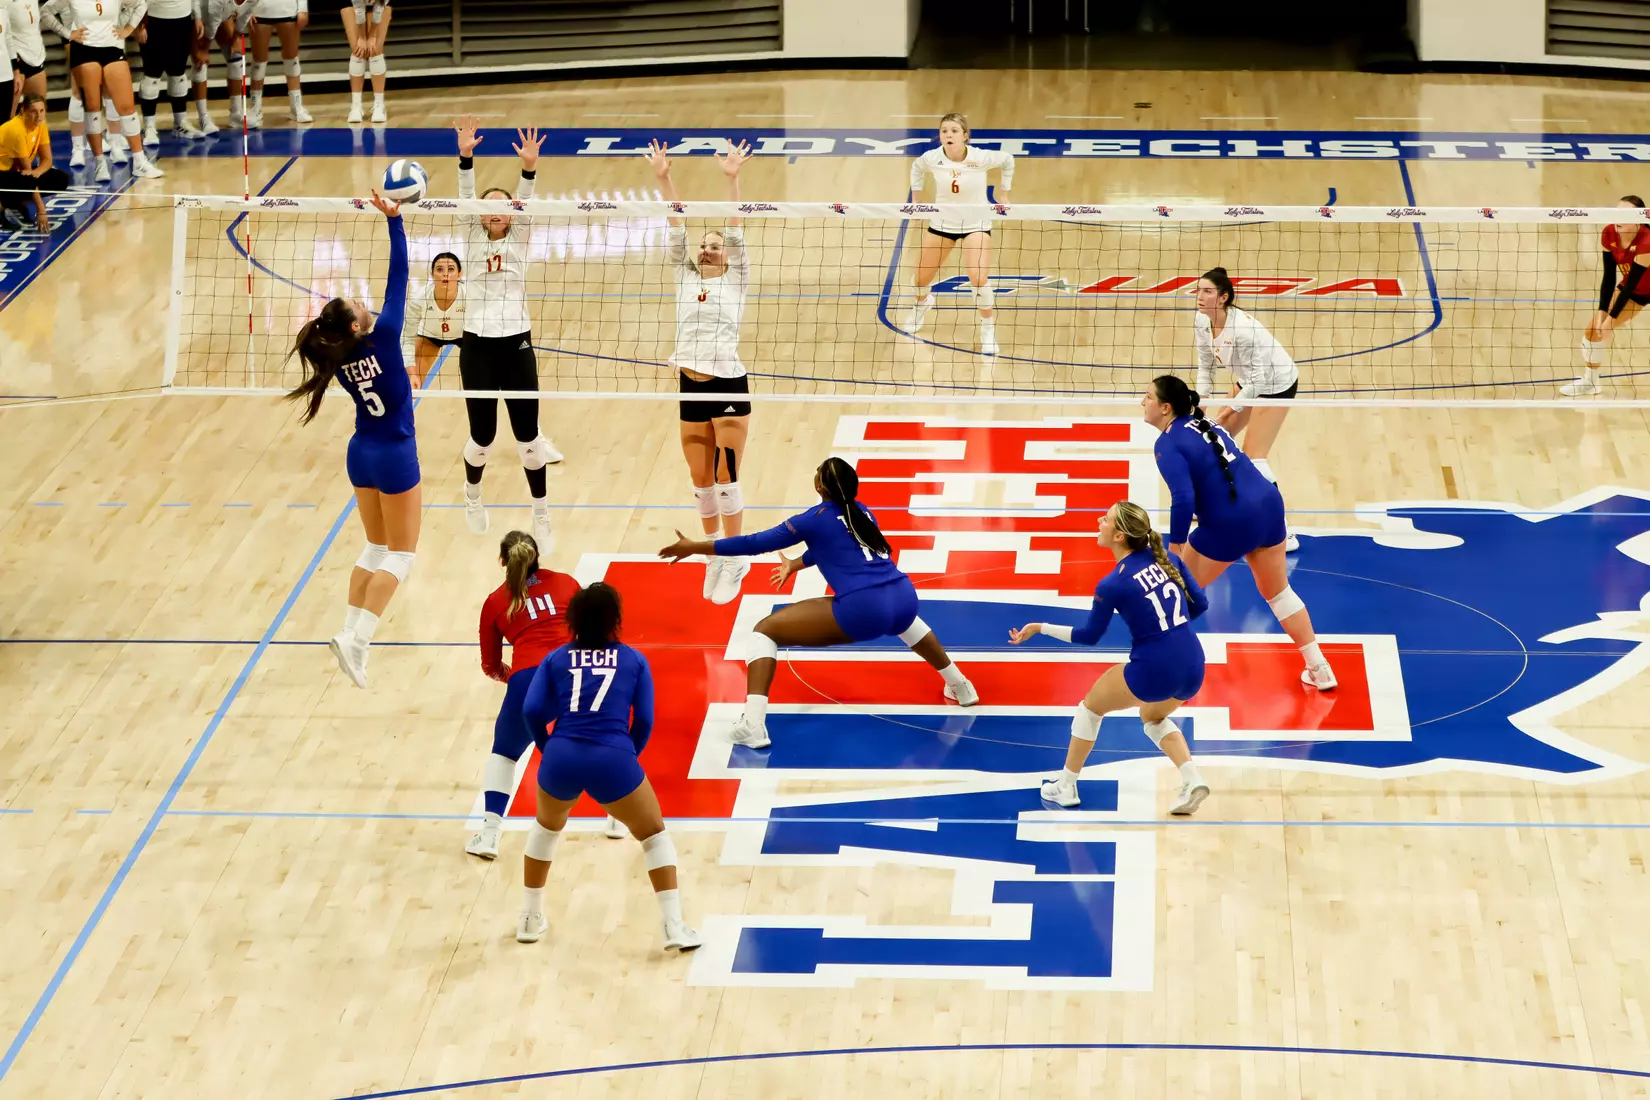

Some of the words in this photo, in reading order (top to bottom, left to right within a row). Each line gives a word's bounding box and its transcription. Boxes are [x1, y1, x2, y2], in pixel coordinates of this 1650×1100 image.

[576, 137, 933, 156] LADY
[951, 180, 960, 194] 6
[340, 354, 383, 383] TECH
[357, 380, 386, 417] 5
[525, 593, 557, 620] 14
[1144, 581, 1188, 632] 12
[568, 648, 618, 668] TECH
[568, 668, 617, 712] 17
